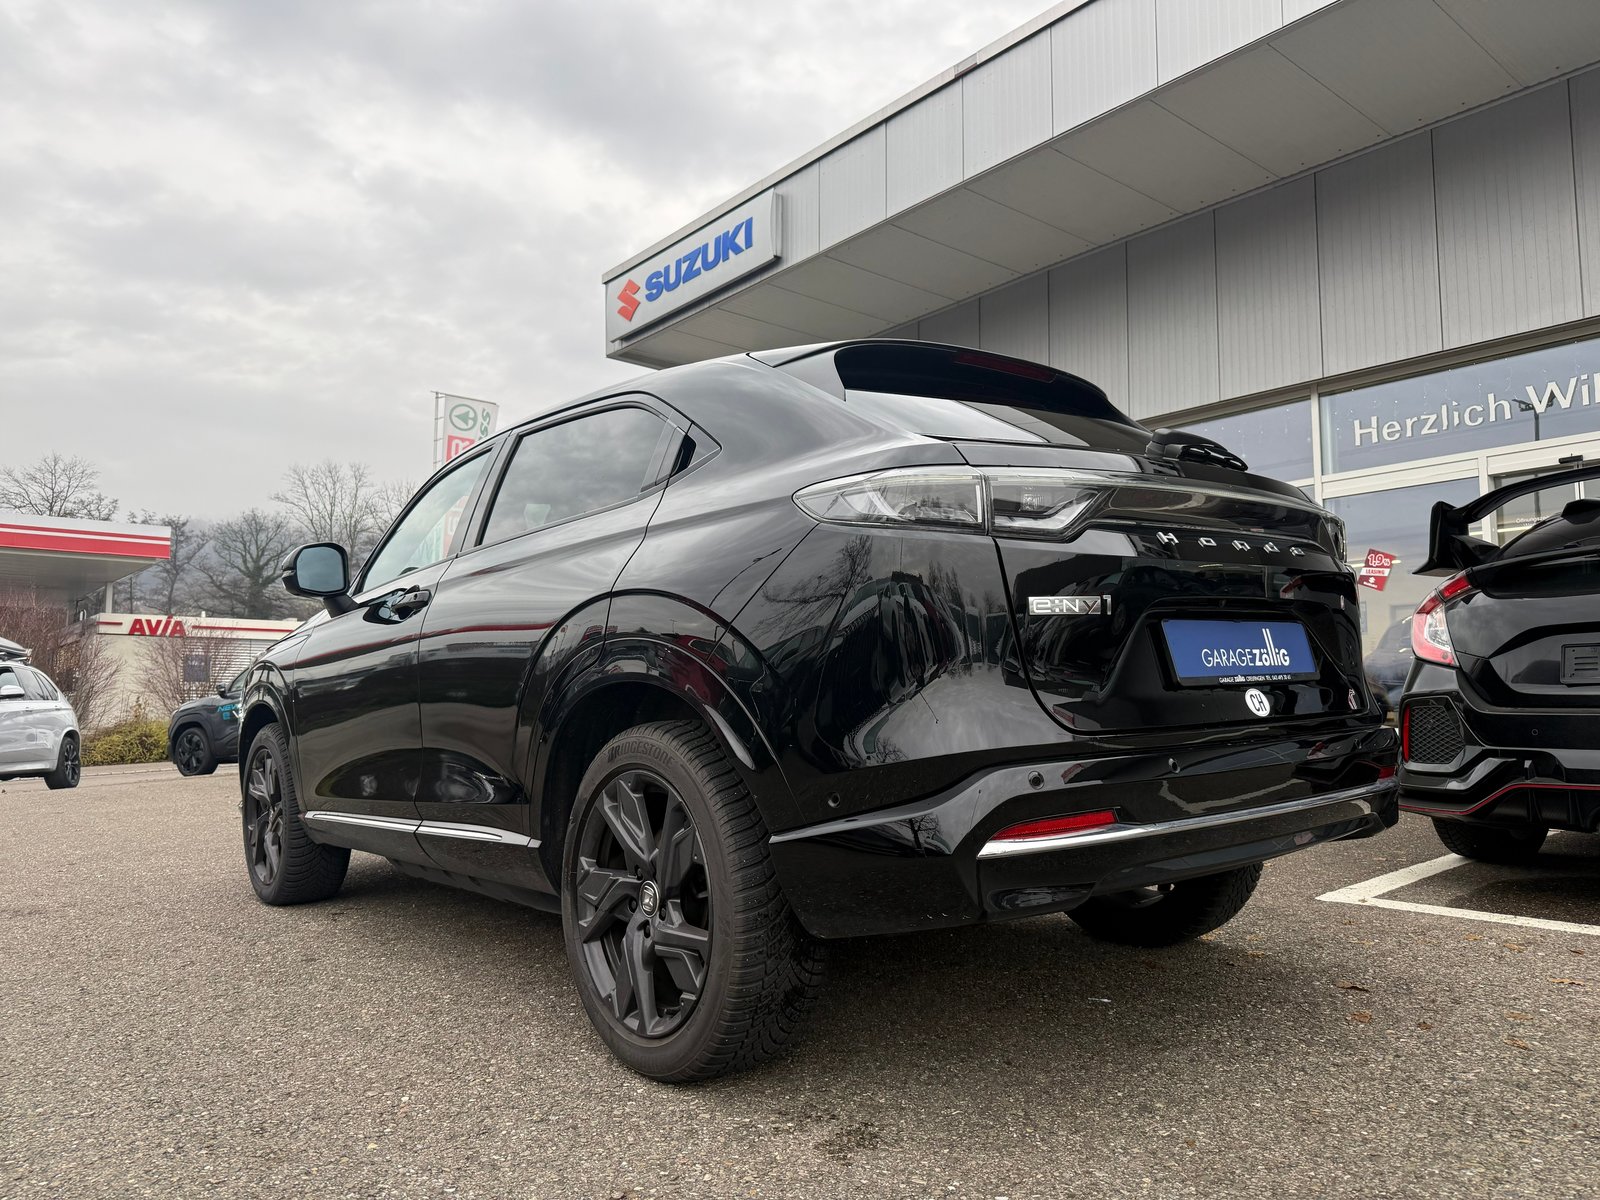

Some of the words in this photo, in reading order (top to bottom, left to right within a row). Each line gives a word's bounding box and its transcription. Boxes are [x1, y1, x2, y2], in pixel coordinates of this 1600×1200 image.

[645, 216, 753, 302] SUZUKI
[1353, 393, 1512, 446] Herzlich
[1156, 531, 1305, 556] HONDA
[128, 614, 187, 638] AVIA
[1249, 693, 1267, 712] CH
[608, 741, 675, 770] BRIDGESTONE
